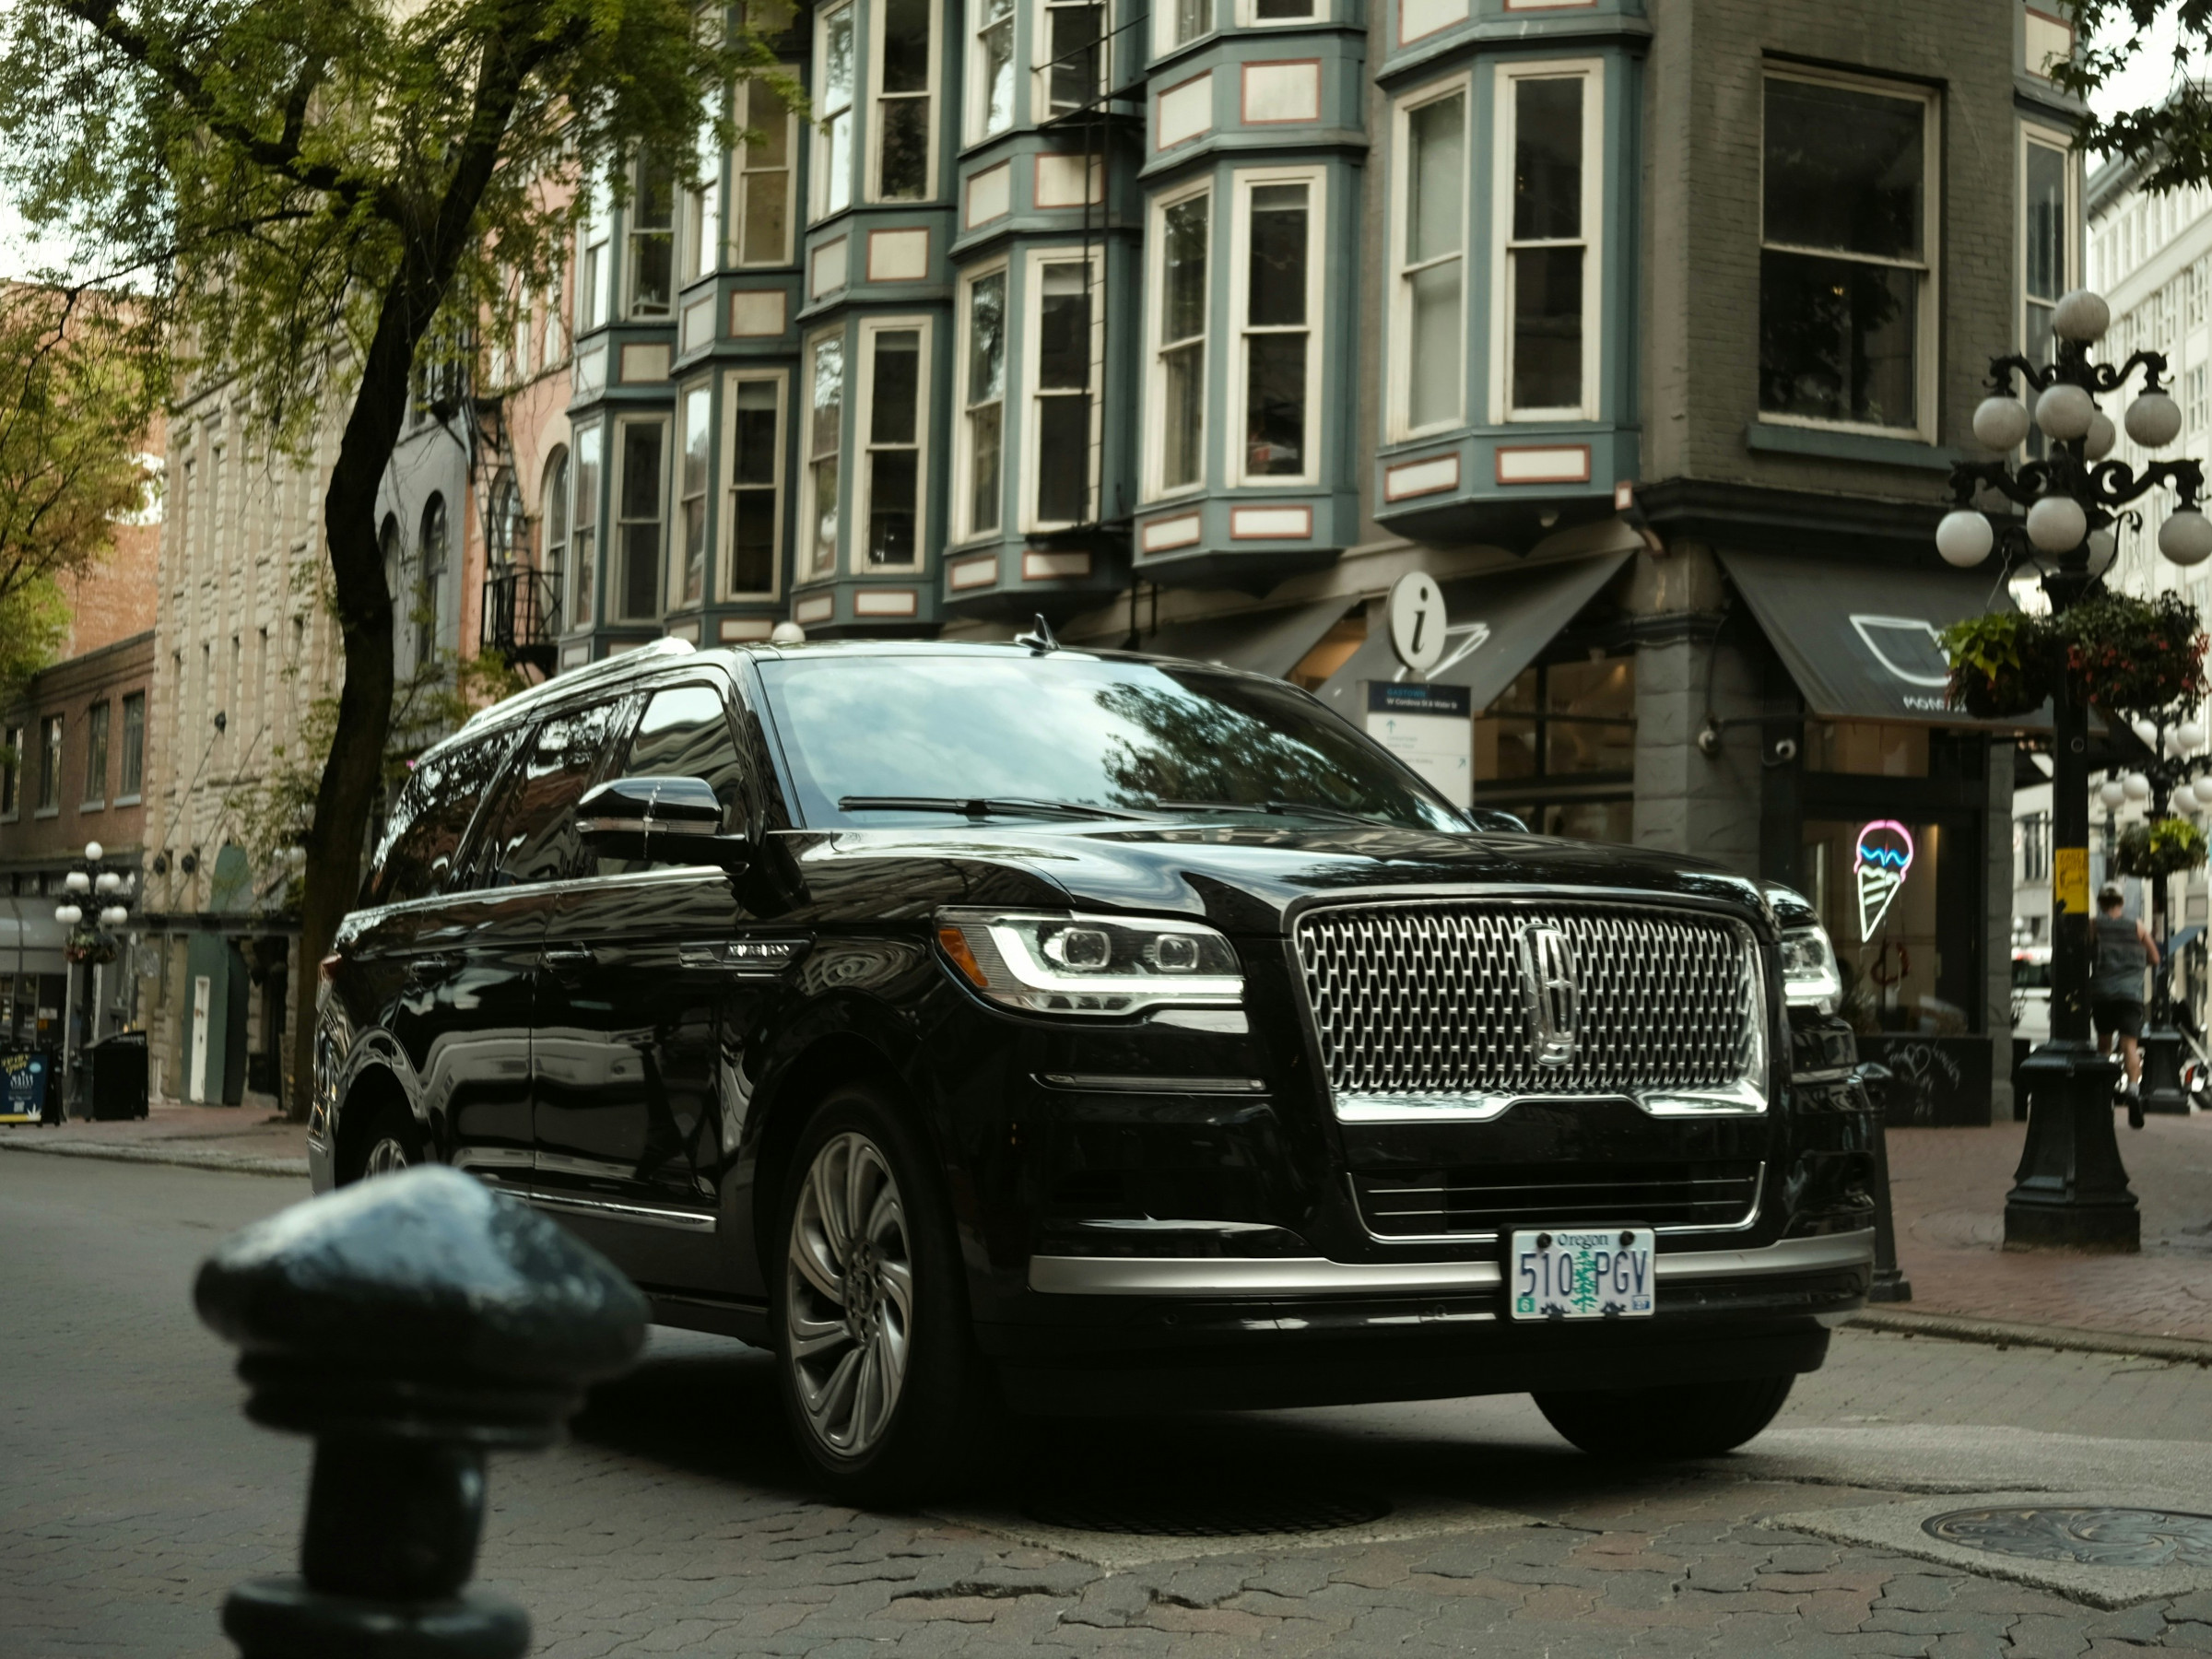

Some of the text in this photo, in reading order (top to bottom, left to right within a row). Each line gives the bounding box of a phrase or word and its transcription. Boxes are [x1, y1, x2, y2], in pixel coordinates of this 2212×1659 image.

[1410, 586, 1429, 655] i
[1387, 688, 1426, 698] GASTOWN
[1558, 1233, 1609, 1250] Oregon
[1520, 1249, 1647, 1297] 510 PGV
